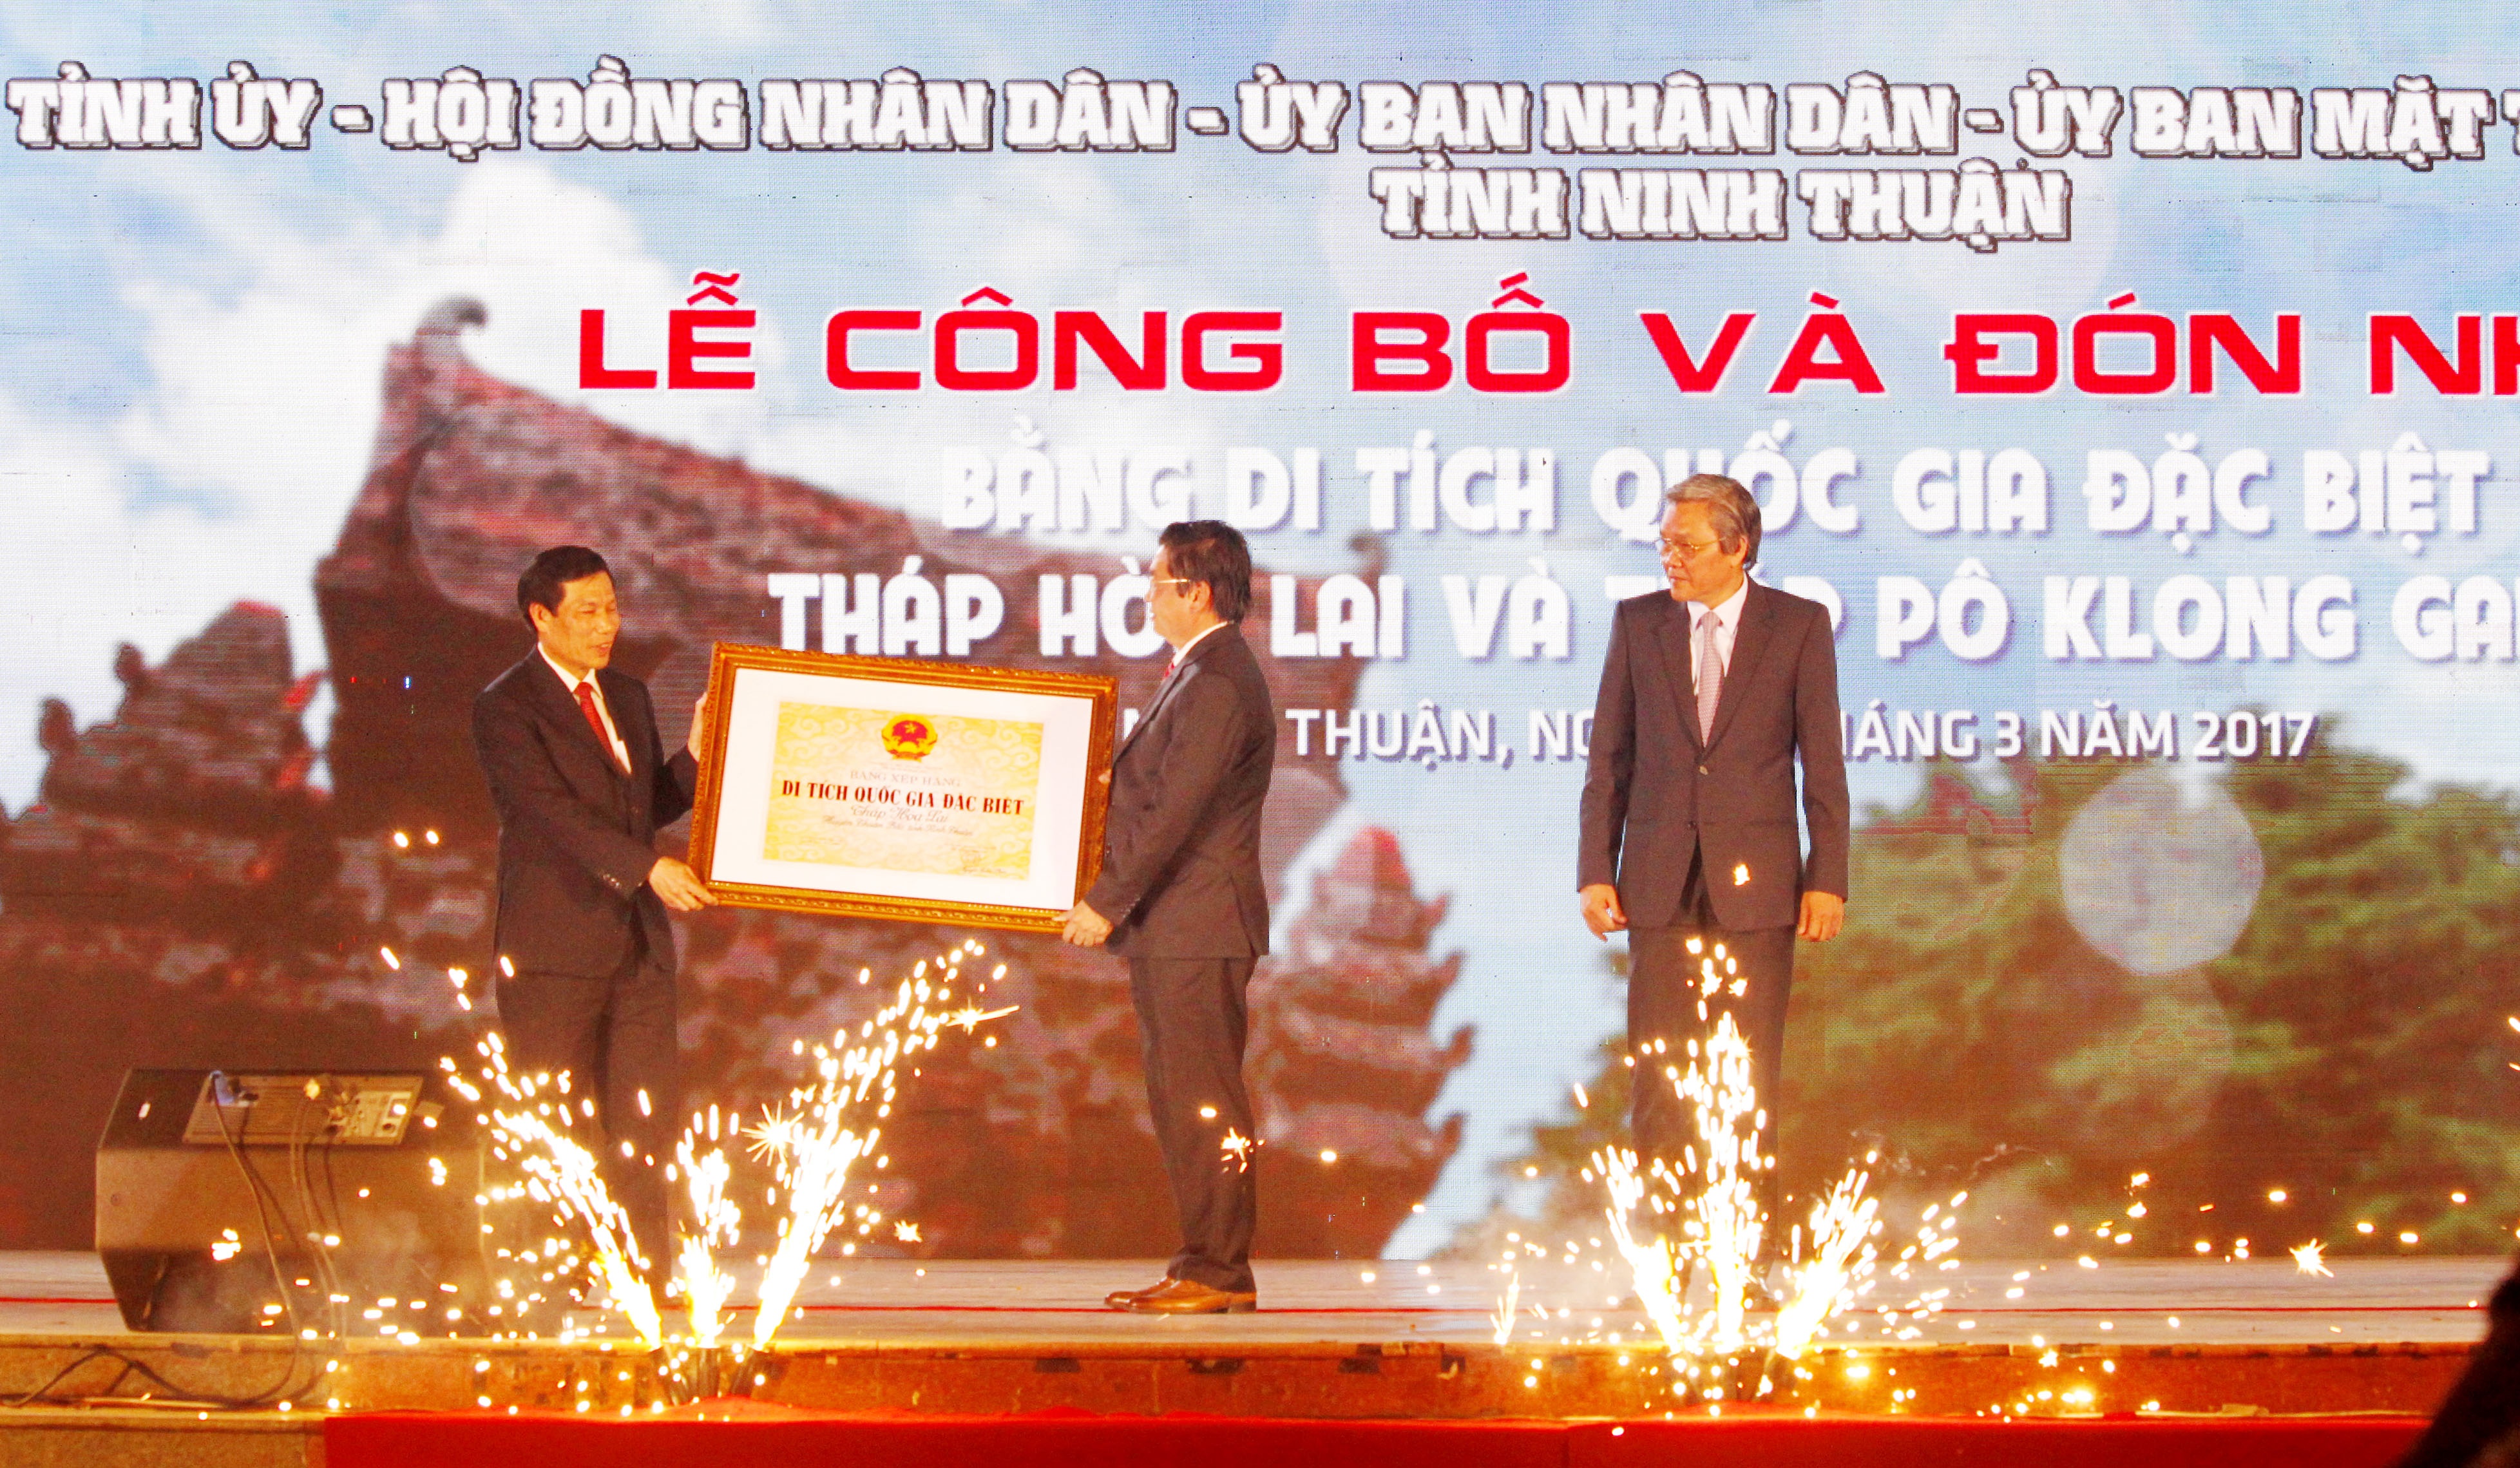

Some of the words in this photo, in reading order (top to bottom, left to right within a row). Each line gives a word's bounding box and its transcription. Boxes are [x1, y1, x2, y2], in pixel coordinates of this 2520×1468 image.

[6, 61, 203, 149] TỈNH
[210, 61, 323, 149] ỦY
[381, 66, 521, 162] HỘI
[528, 54, 751, 150] ĐỒNG
[759, 66, 995, 151] NHÂN
[1004, 67, 1178, 152] DÂN
[1236, 63, 1350, 153] ỦY
[1358, 81, 1533, 153] BAN
[1542, 70, 1777, 155] NHÂN
[1784, 70, 1960, 155] DÂN
[2010, 68, 2123, 158] ỦY
[2130, 85, 2303, 160] BAN
[2311, 74, 2496, 172] MẶT
[1369, 150, 1570, 240] TỈNH
[1578, 167, 1788, 241] NINH
[1797, 157, 2072, 253] THUẬN
[580, 271, 756, 390] LỄ
[826, 286, 1283, 392] CÔNG
[1352, 272, 1570, 393] BỐ
[1639, 291, 1885, 394] VÀ
[1944, 292, 2300, 395] ĐÓN
[942, 416, 1196, 533] BẰNG
[1227, 448, 1324, 533] DI
[1355, 428, 1556, 533] TÍCH
[1894, 447, 2050, 535] GIA
[2082, 431, 2274, 555] ĐẶC
[2304, 431, 2493, 557] BIỆT
[767, 556, 1005, 657] THÁP
[1272, 574, 1407, 660] LAI
[1442, 558, 1572, 660] VÀ
[1876, 558, 2012, 662] PÔ
[2043, 574, 2359, 663] KLONG
[1995, 710, 2024, 759] 3
[2041, 700, 2179, 761] NĂM
[2193, 710, 2320, 761] 2017
[782, 780, 800, 797] DI
[808, 779, 848, 801] TÍCH
[855, 785, 901, 805] QUỐC
[906, 790, 934, 808] GIA
